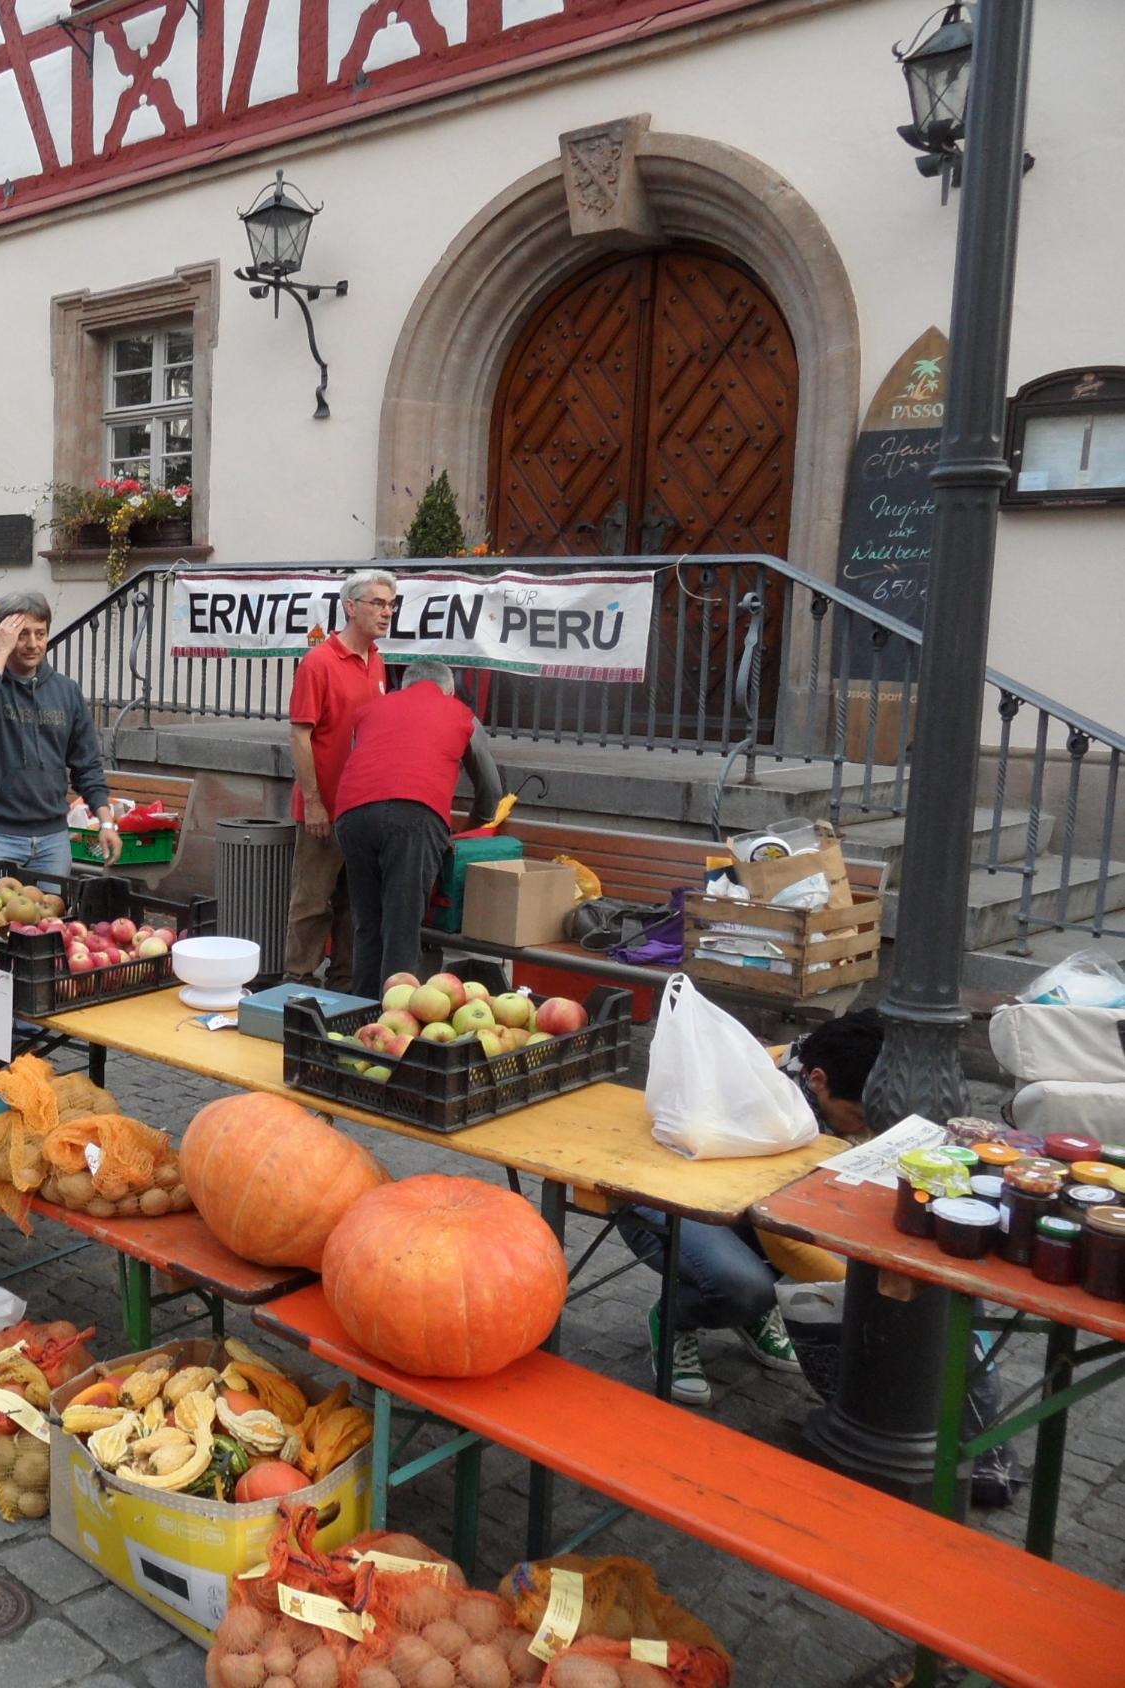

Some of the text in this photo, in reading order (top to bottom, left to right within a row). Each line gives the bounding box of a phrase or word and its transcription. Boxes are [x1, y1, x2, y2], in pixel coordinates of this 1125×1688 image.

[189, 592, 313, 635] ERNTE
[321, 592, 484, 640] TLEN
[502, 589, 538, 606] FÜR
